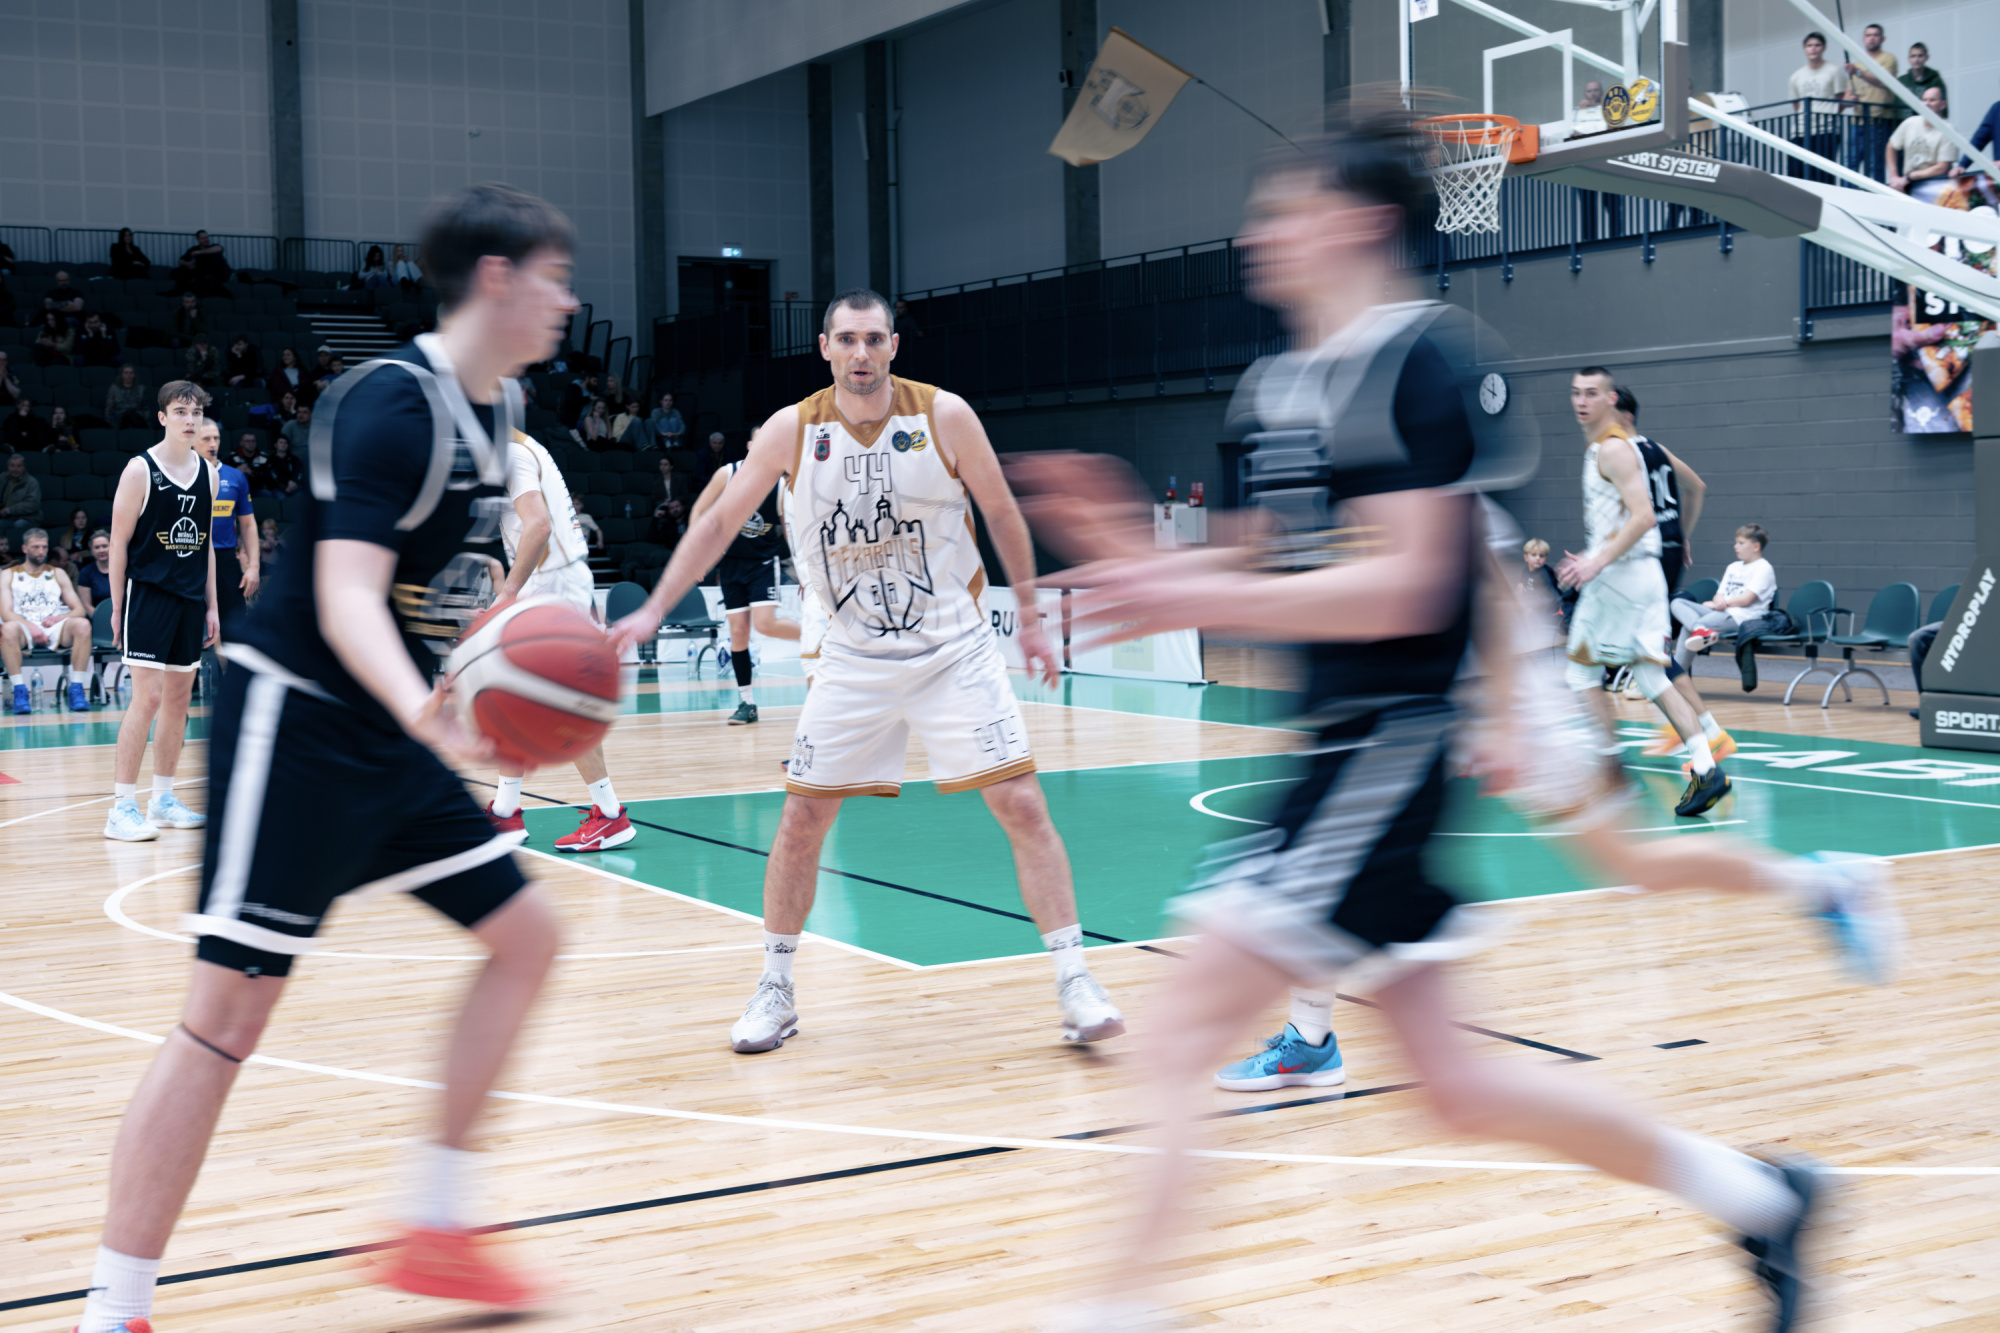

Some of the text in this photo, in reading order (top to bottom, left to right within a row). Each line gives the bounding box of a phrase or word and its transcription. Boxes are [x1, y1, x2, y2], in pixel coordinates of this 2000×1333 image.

[844, 452, 893, 495] 44
[177, 494, 197, 514] 77
[1939, 567, 1997, 673] HYDROPLAY
[1935, 709, 2000, 732] SPORT
